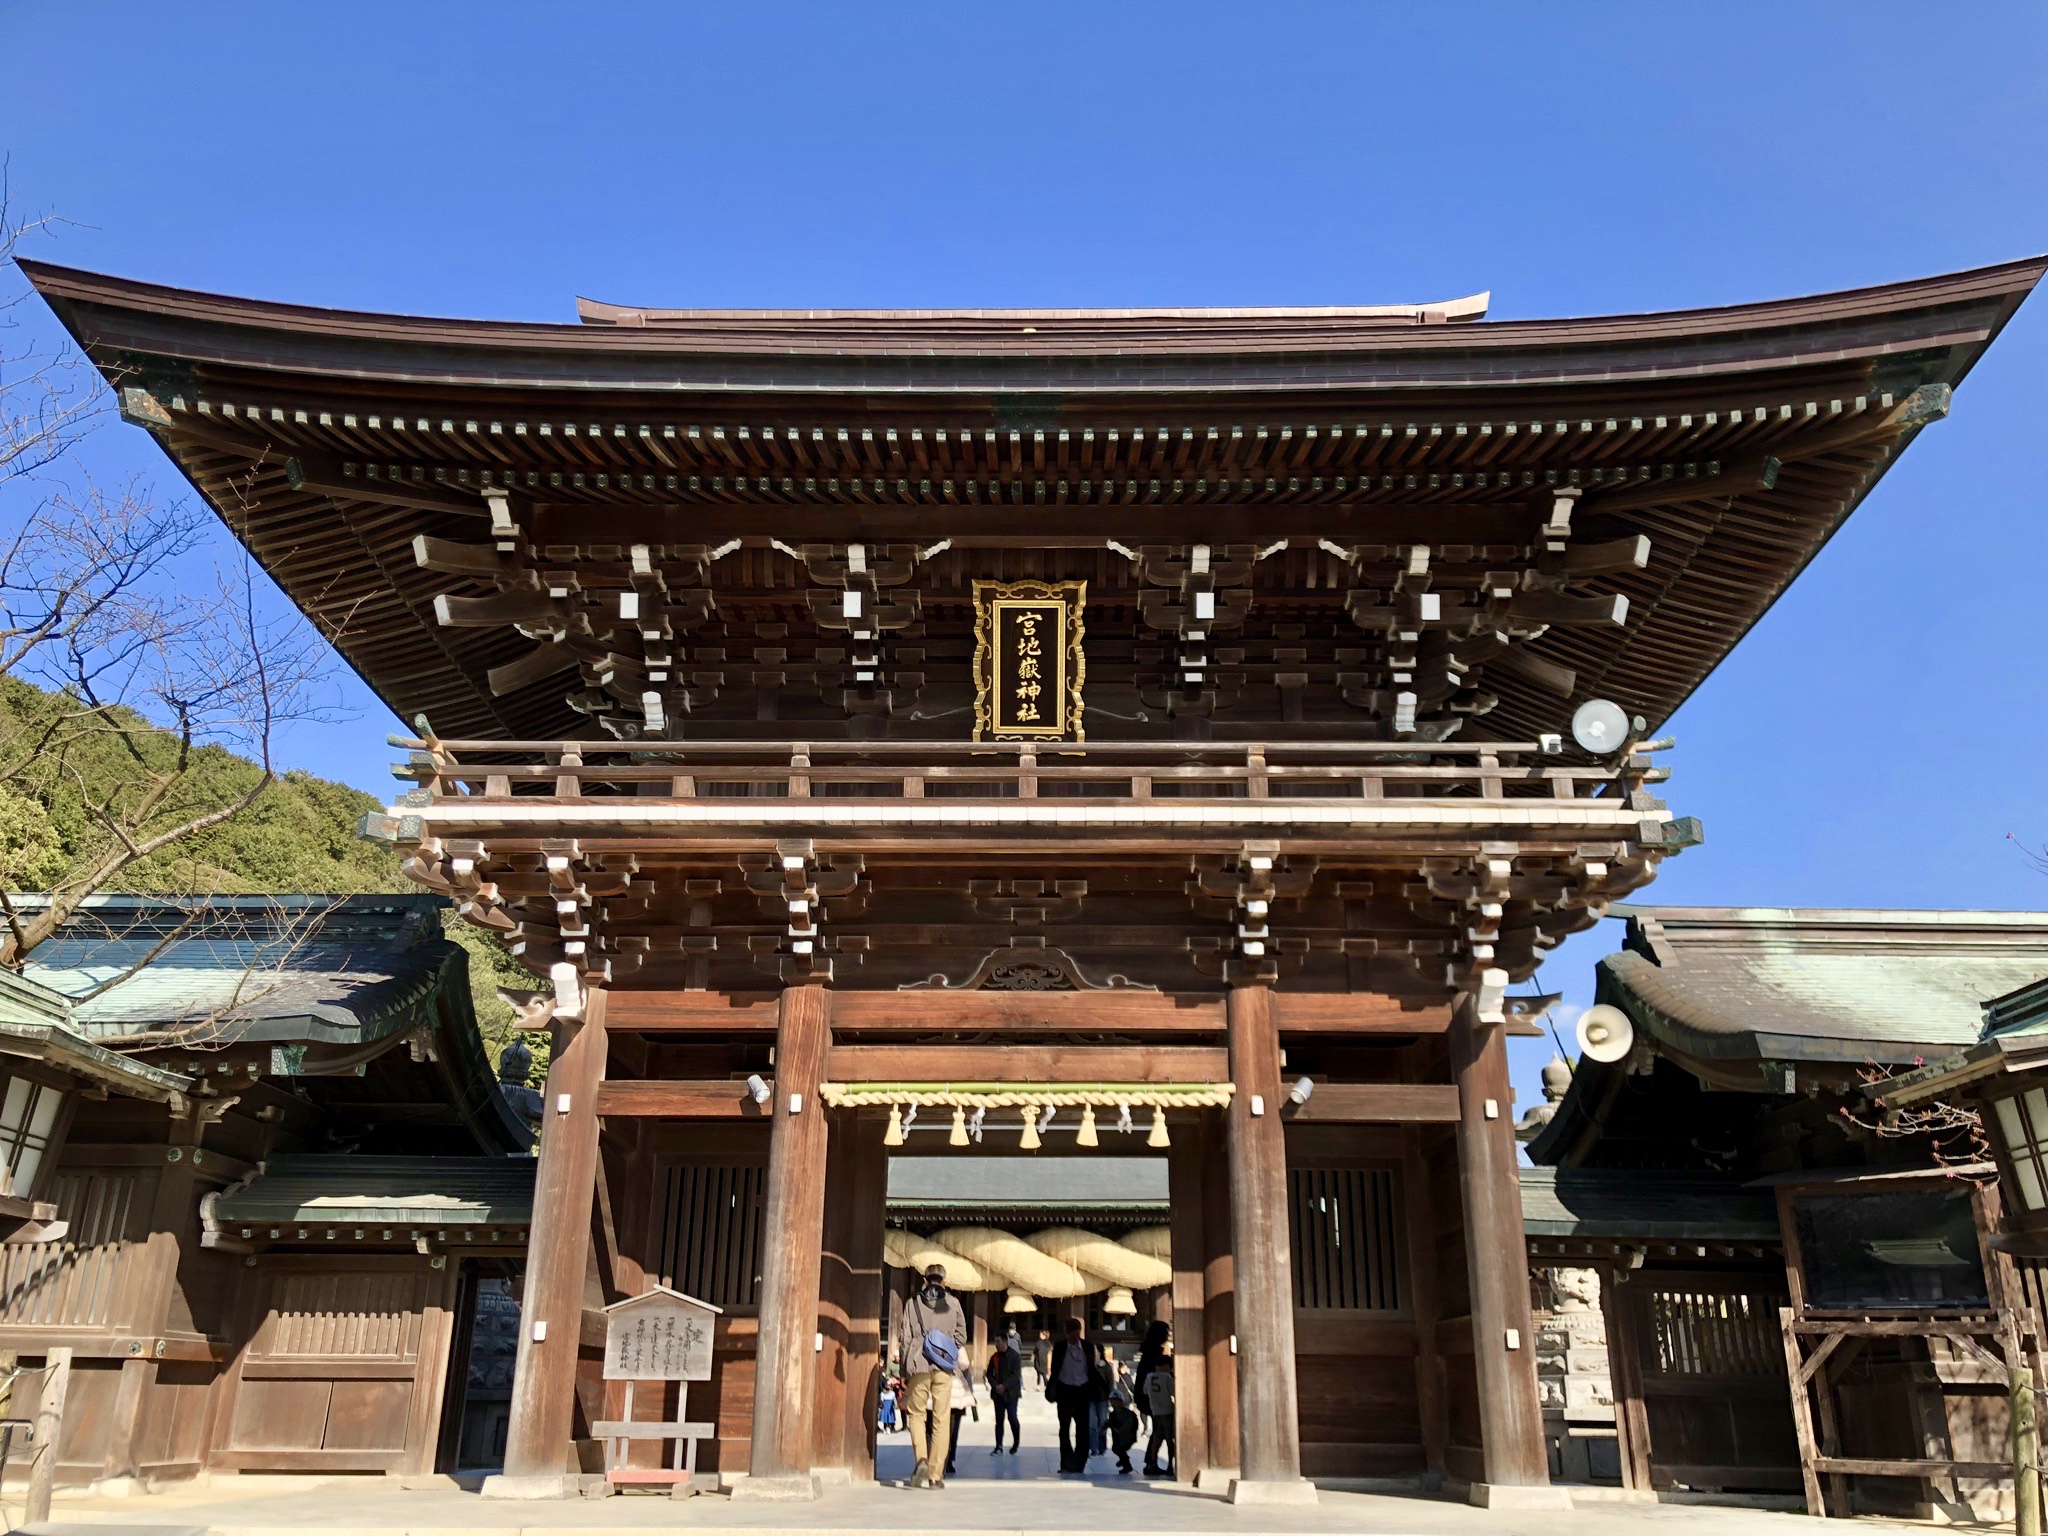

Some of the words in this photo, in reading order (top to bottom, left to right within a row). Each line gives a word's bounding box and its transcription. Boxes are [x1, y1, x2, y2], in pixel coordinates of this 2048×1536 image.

[1015, 611, 1043, 722] 宮地嶽神社
[1151, 1376, 1161, 1392] 5
